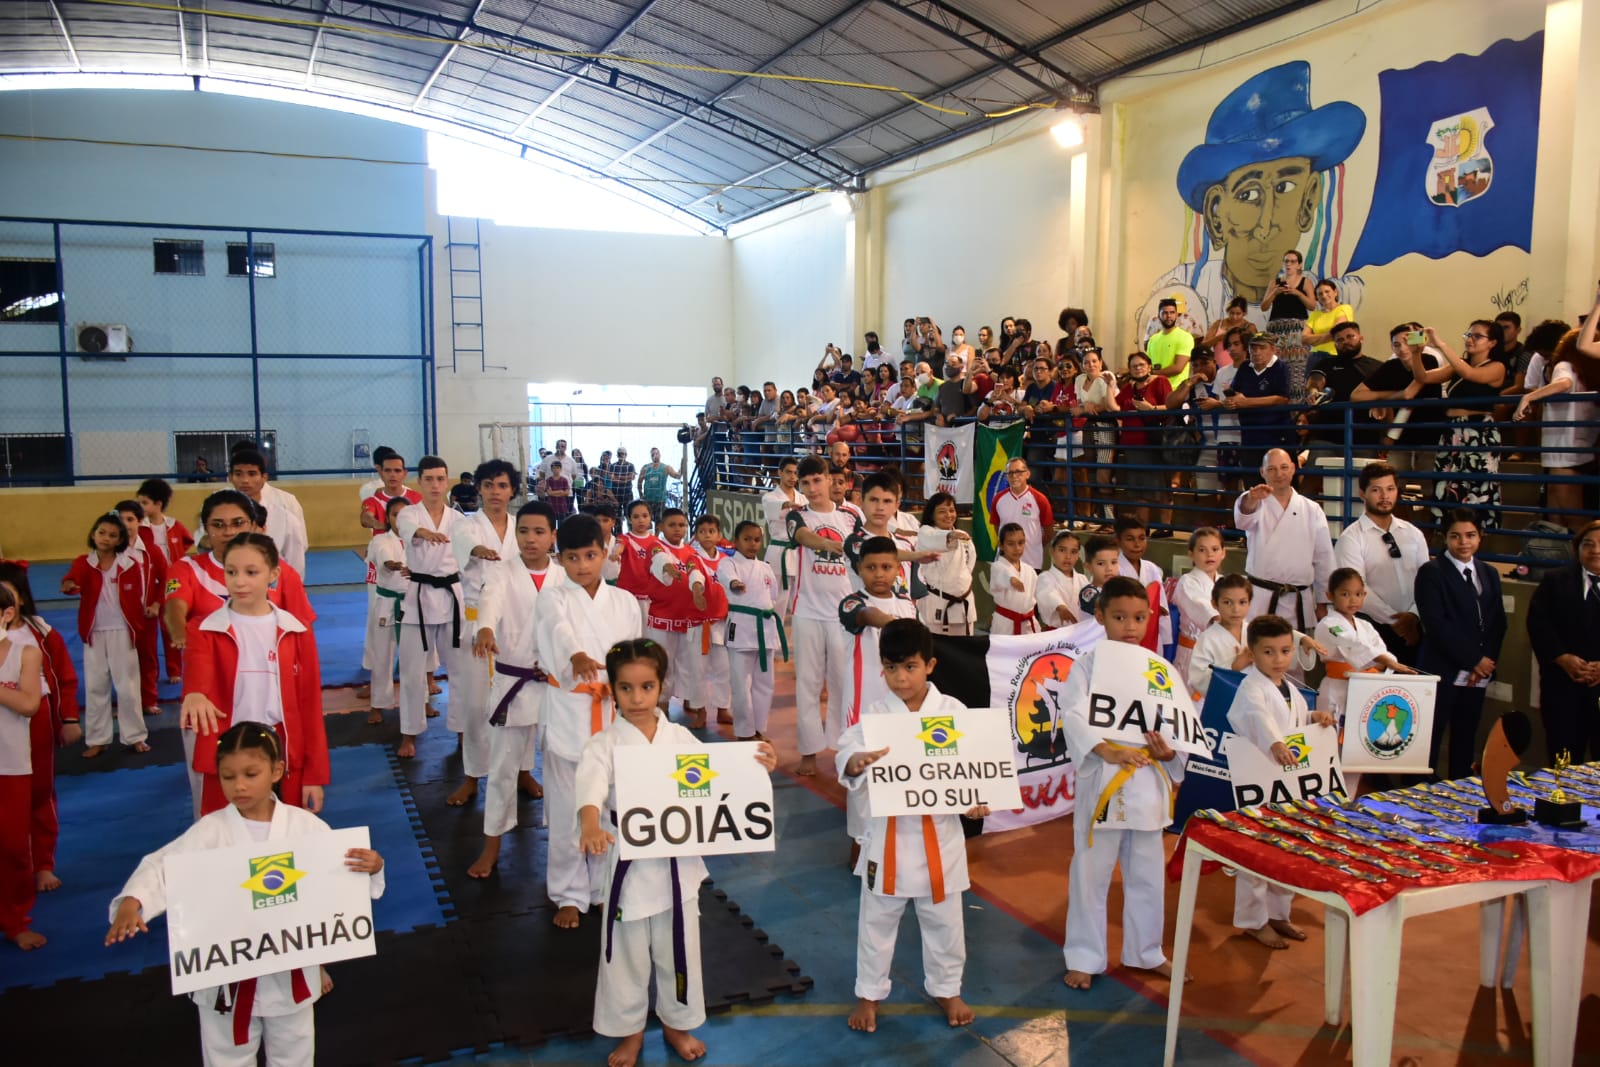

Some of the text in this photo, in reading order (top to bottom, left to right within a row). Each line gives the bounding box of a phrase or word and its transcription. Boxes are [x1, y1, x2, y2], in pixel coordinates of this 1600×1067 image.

[1088, 692, 1211, 752] BAHIA
[927, 748, 959, 757] CEBK
[871, 760, 1014, 784] RIO GRANDE
[1234, 756, 1348, 810] PARÁ
[679, 787, 711, 798] CEBK
[904, 787, 989, 808] DO SUL
[620, 792, 773, 848] GOIÁS
[254, 891, 298, 909] CEBK
[173, 912, 373, 978] MARANHÃO
